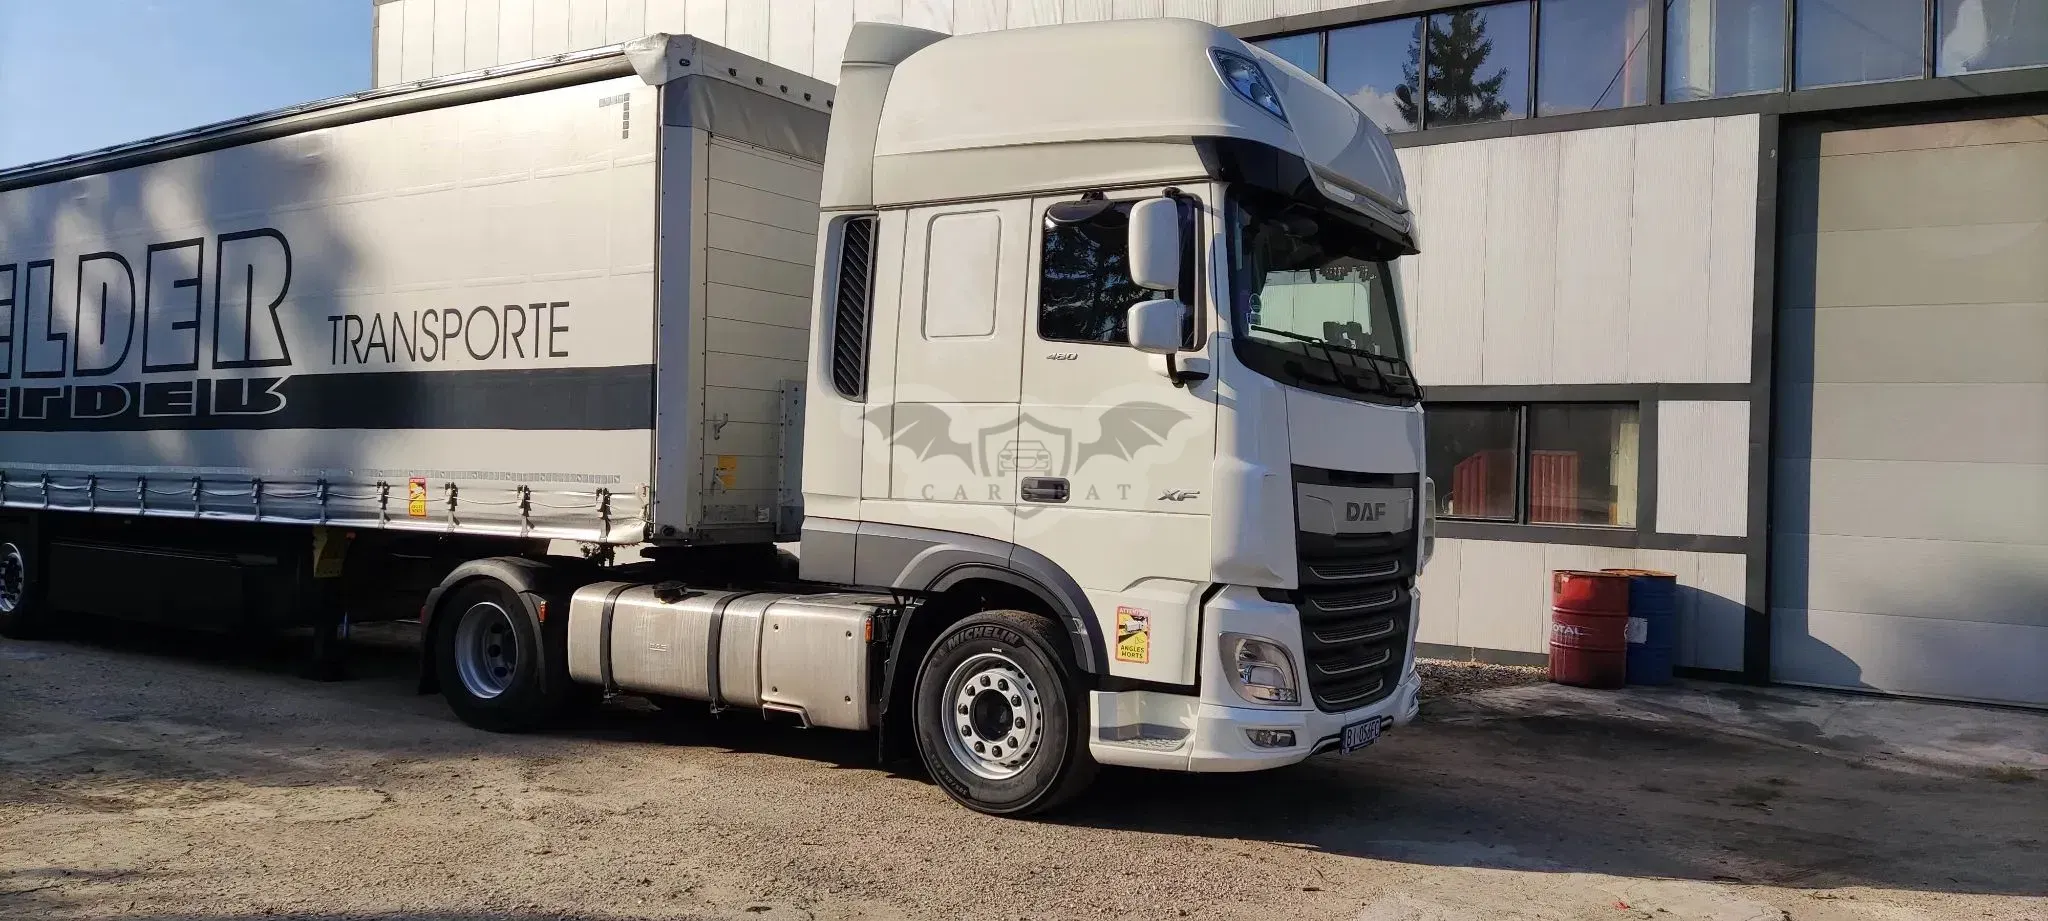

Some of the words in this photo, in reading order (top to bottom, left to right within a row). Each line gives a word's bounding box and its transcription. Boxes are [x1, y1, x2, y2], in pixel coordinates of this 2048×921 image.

[0, 228, 292, 379] LDER
[327, 301, 570, 366] TRANSPORTE
[1046, 352, 1079, 361] 480
[1157, 489, 1201, 502] XF
[1346, 502, 1386, 522] DAF
[947, 626, 1020, 648] MICHELIN
[1552, 623, 1584, 635] OTAL
[1120, 645, 1145, 653] ANGLES
